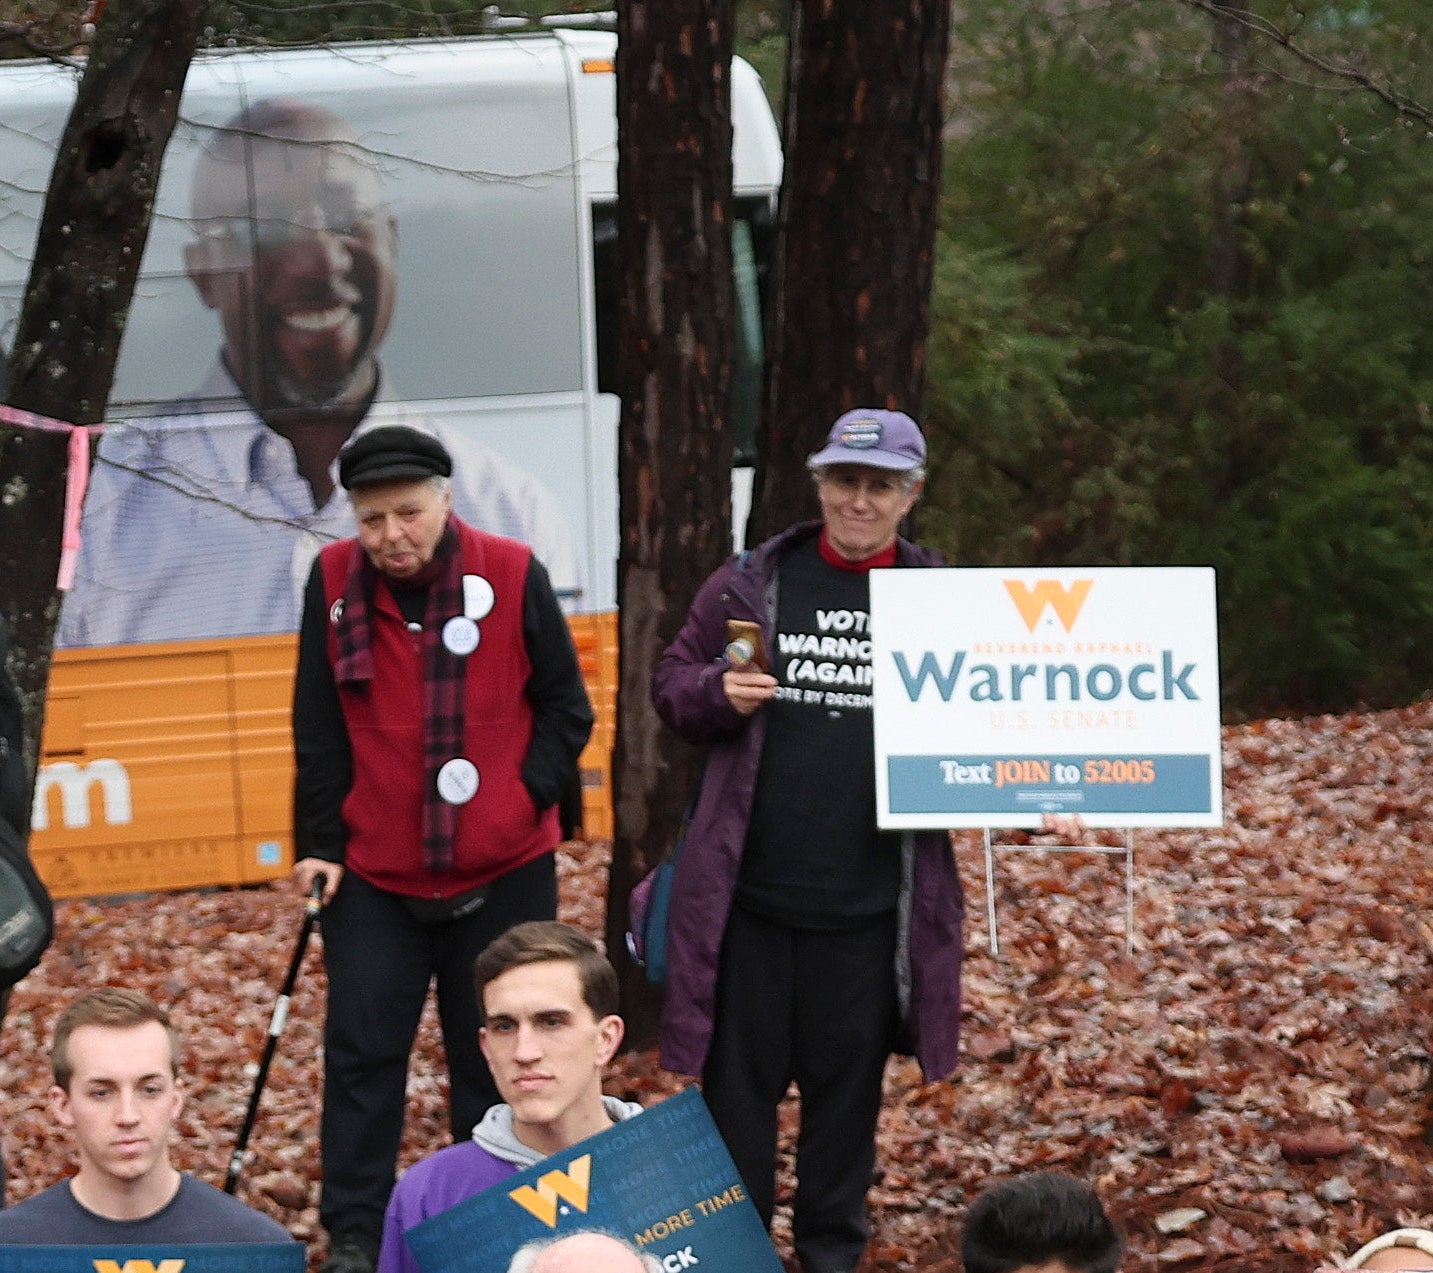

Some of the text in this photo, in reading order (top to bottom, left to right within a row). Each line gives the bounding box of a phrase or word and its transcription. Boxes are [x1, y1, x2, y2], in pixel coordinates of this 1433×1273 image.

[892, 650, 1199, 703] Warnock
[990, 710, 1136, 728] U.S. SENATE
[940, 760, 1155, 787] Text JOIN to 52005
